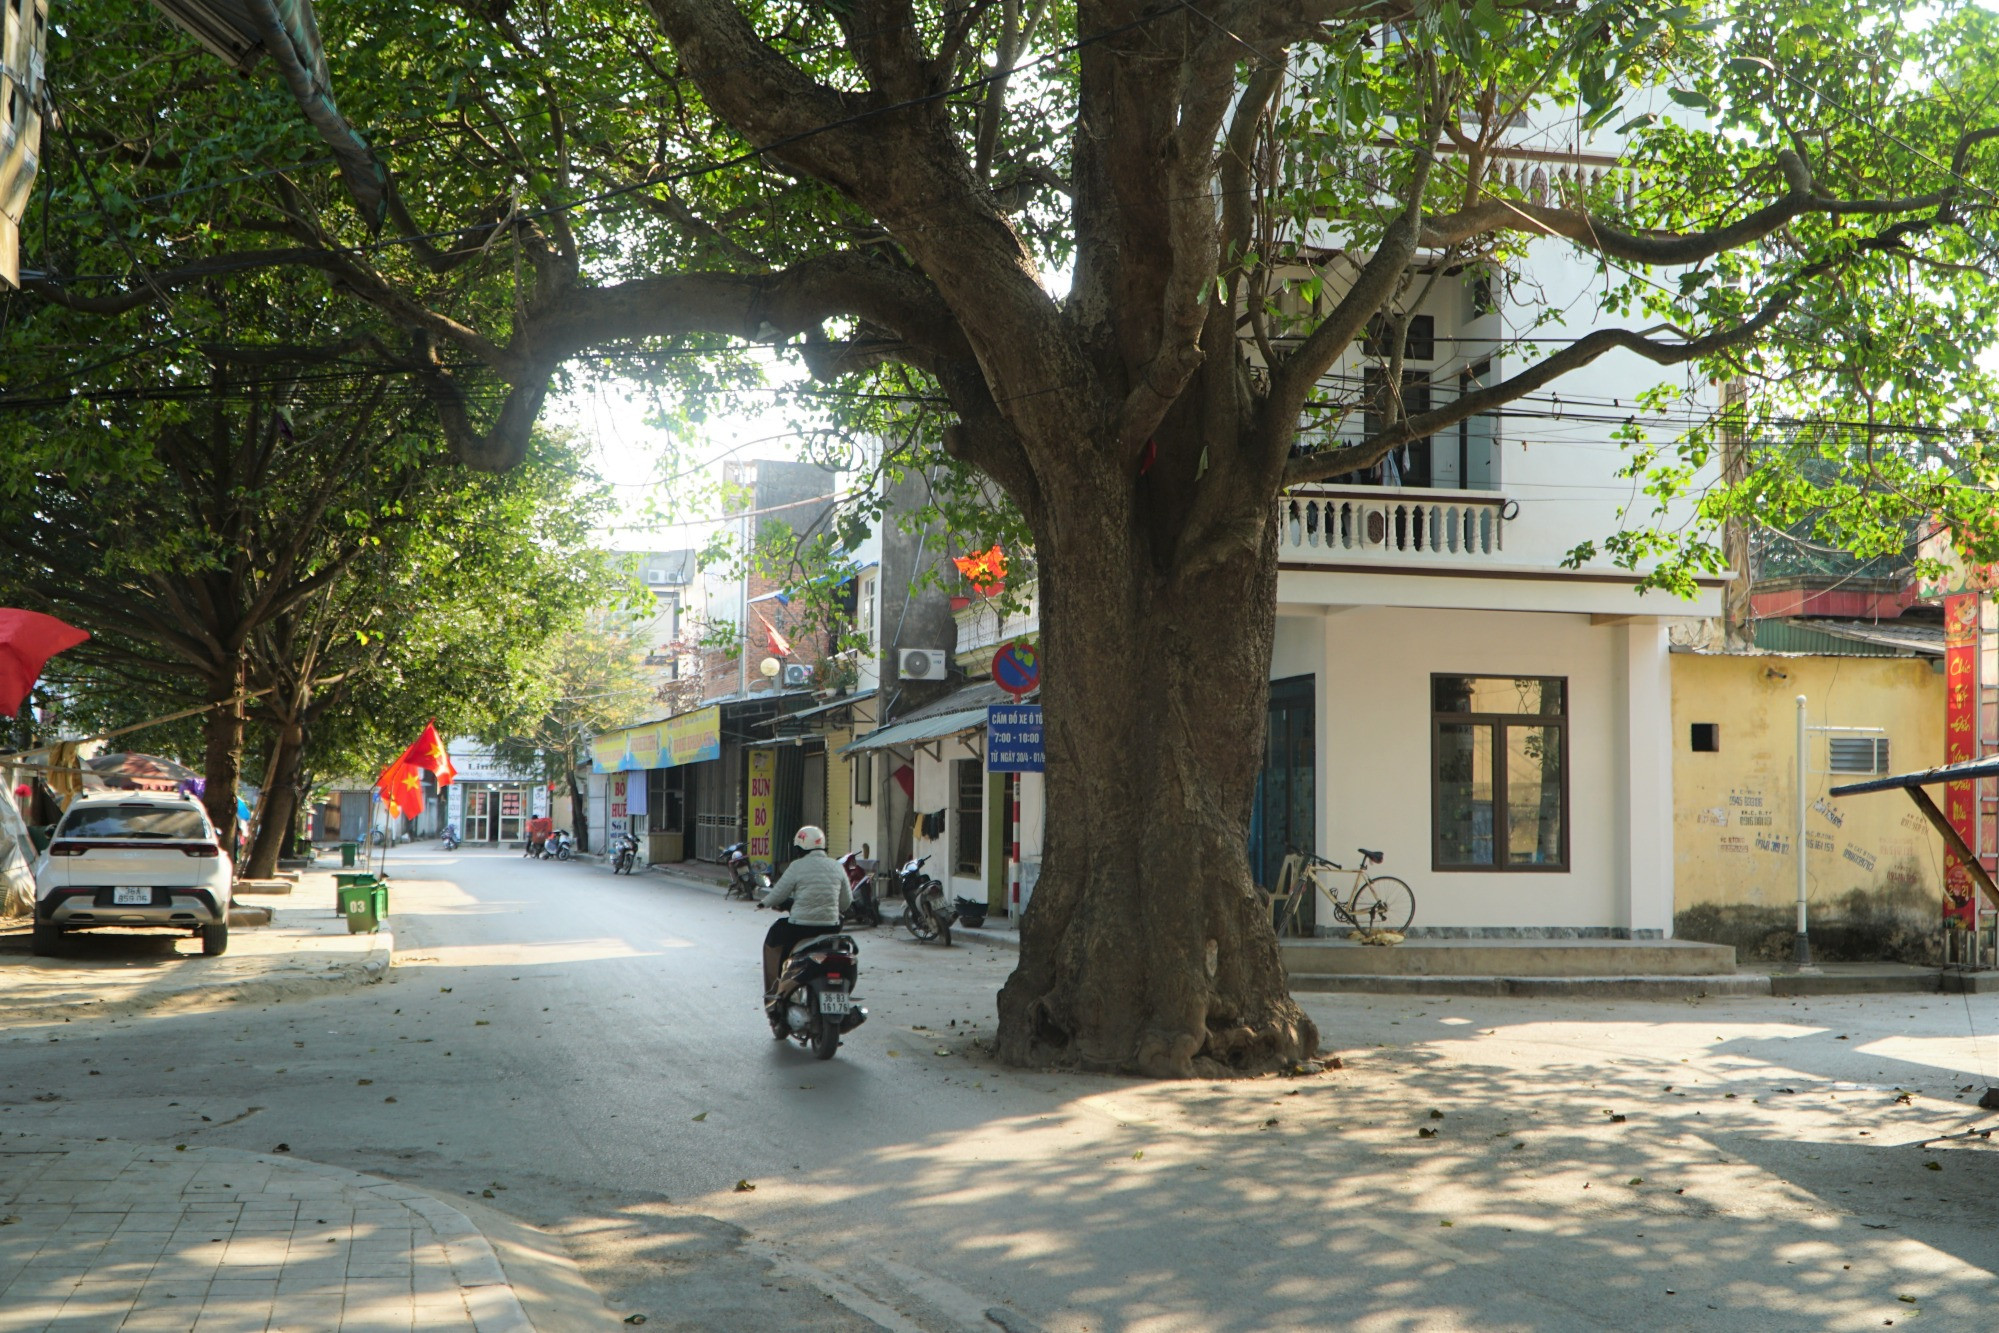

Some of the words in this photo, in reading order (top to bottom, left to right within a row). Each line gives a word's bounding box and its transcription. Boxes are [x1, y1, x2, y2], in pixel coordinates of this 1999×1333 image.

[1019, 713, 1027, 725] XE
[1028, 711, 1034, 725] Ô
[994, 732, 1011, 744] 7:00
[1019, 732, 1040, 744] 10:00
[1000, 749, 1016, 763] NGÀY
[751, 773, 770, 797] BÚN
[754, 803, 767, 827] BÒ
[751, 828, 770, 857] HUẾ
[350, 900, 366, 913] 03
